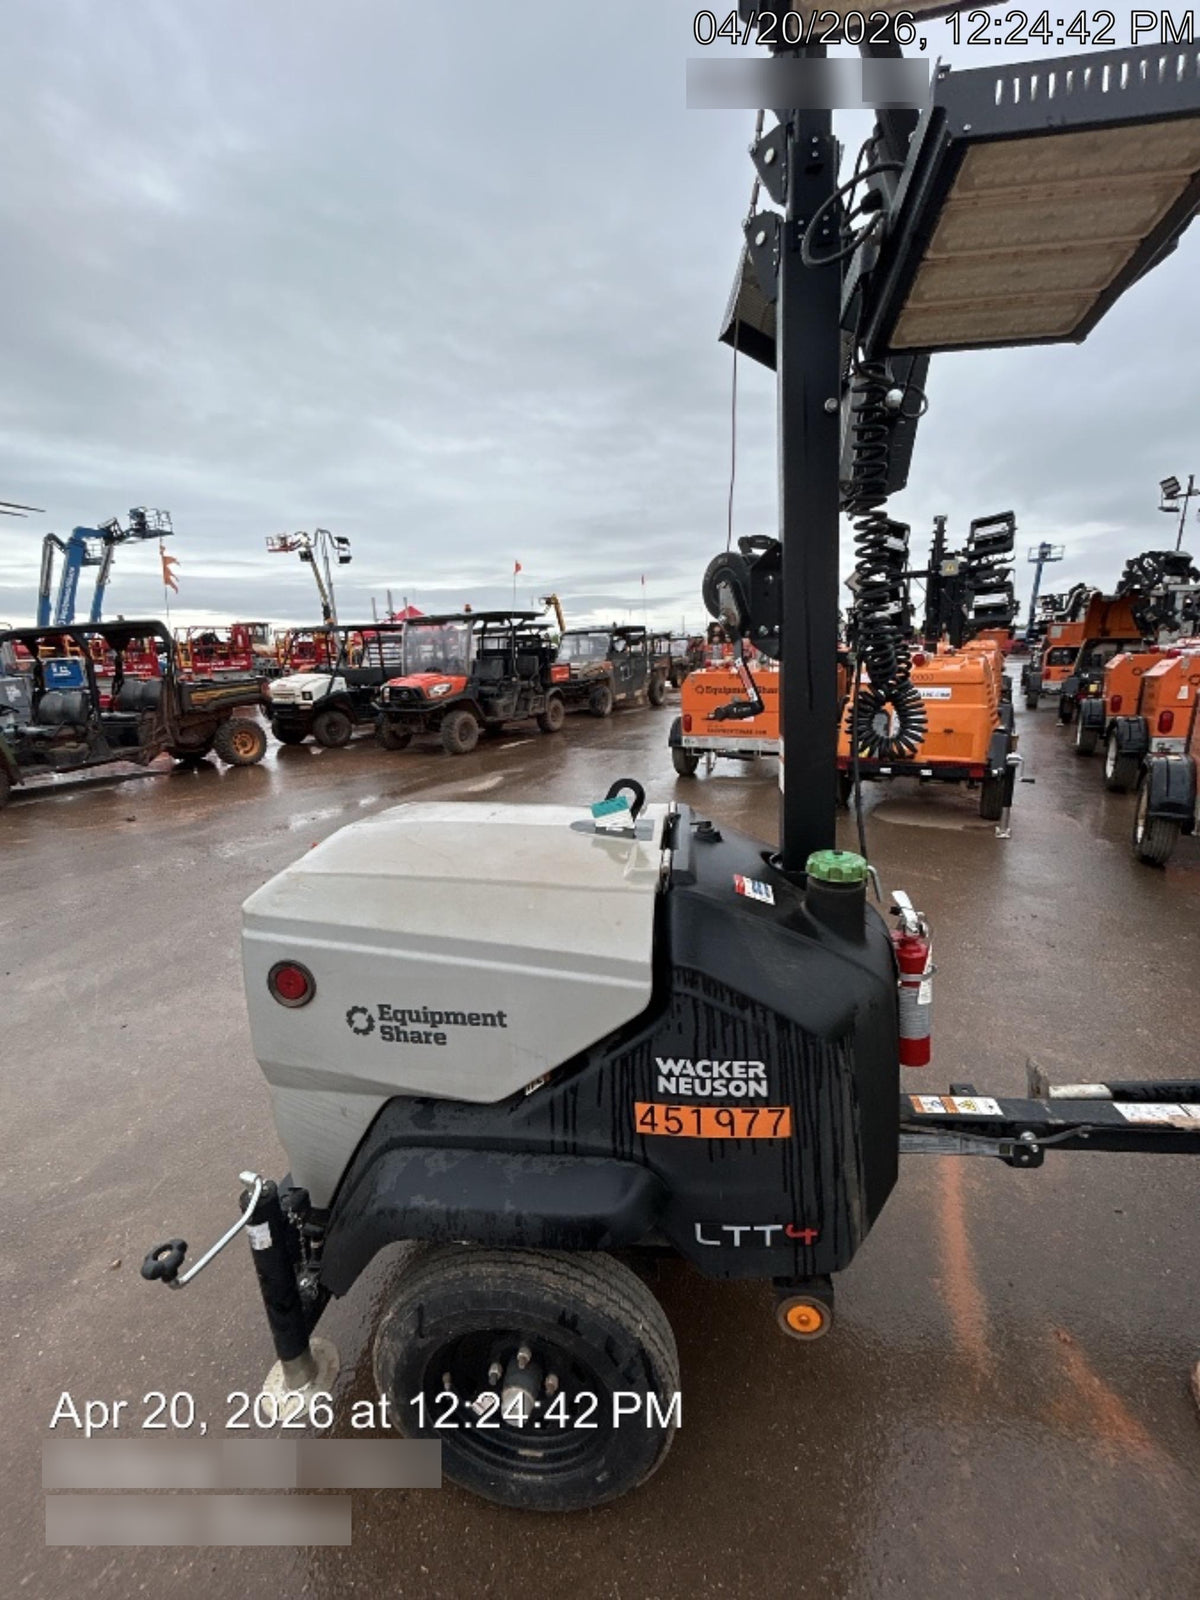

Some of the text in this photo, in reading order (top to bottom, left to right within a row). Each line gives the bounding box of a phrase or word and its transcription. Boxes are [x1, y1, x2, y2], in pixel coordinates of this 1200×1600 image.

[377, 1004, 507, 1028] Equipment
[380, 1025, 447, 1045] Share
[655, 1057, 767, 1078] WACKER
[657, 1076, 769, 1098] NEUSON
[639, 1105, 786, 1137] 451977
[694, 1223, 818, 1247] LTT4
